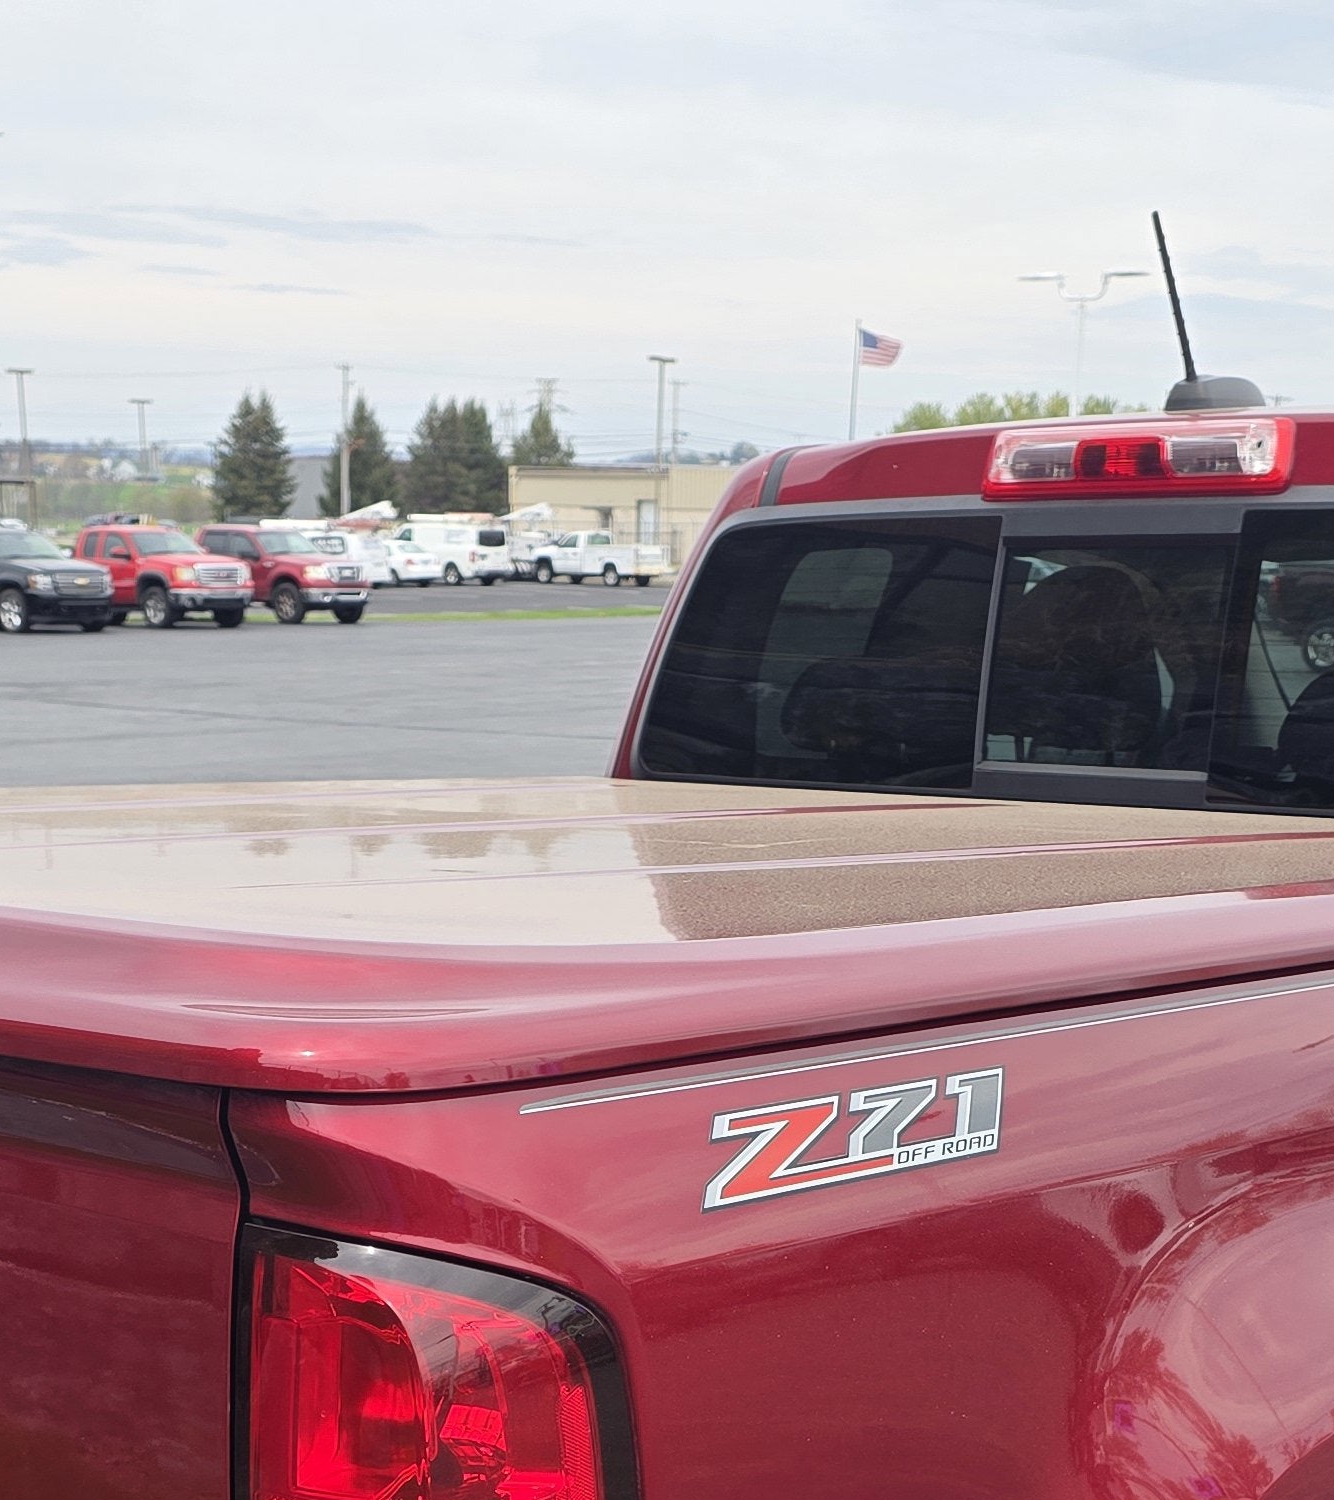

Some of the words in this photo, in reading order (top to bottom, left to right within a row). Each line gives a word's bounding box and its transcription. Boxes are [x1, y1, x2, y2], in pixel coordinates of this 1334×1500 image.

[701, 1066, 1004, 1213] Z71
[897, 1144, 936, 1165] OFF
[941, 1133, 995, 1157] ROAD
